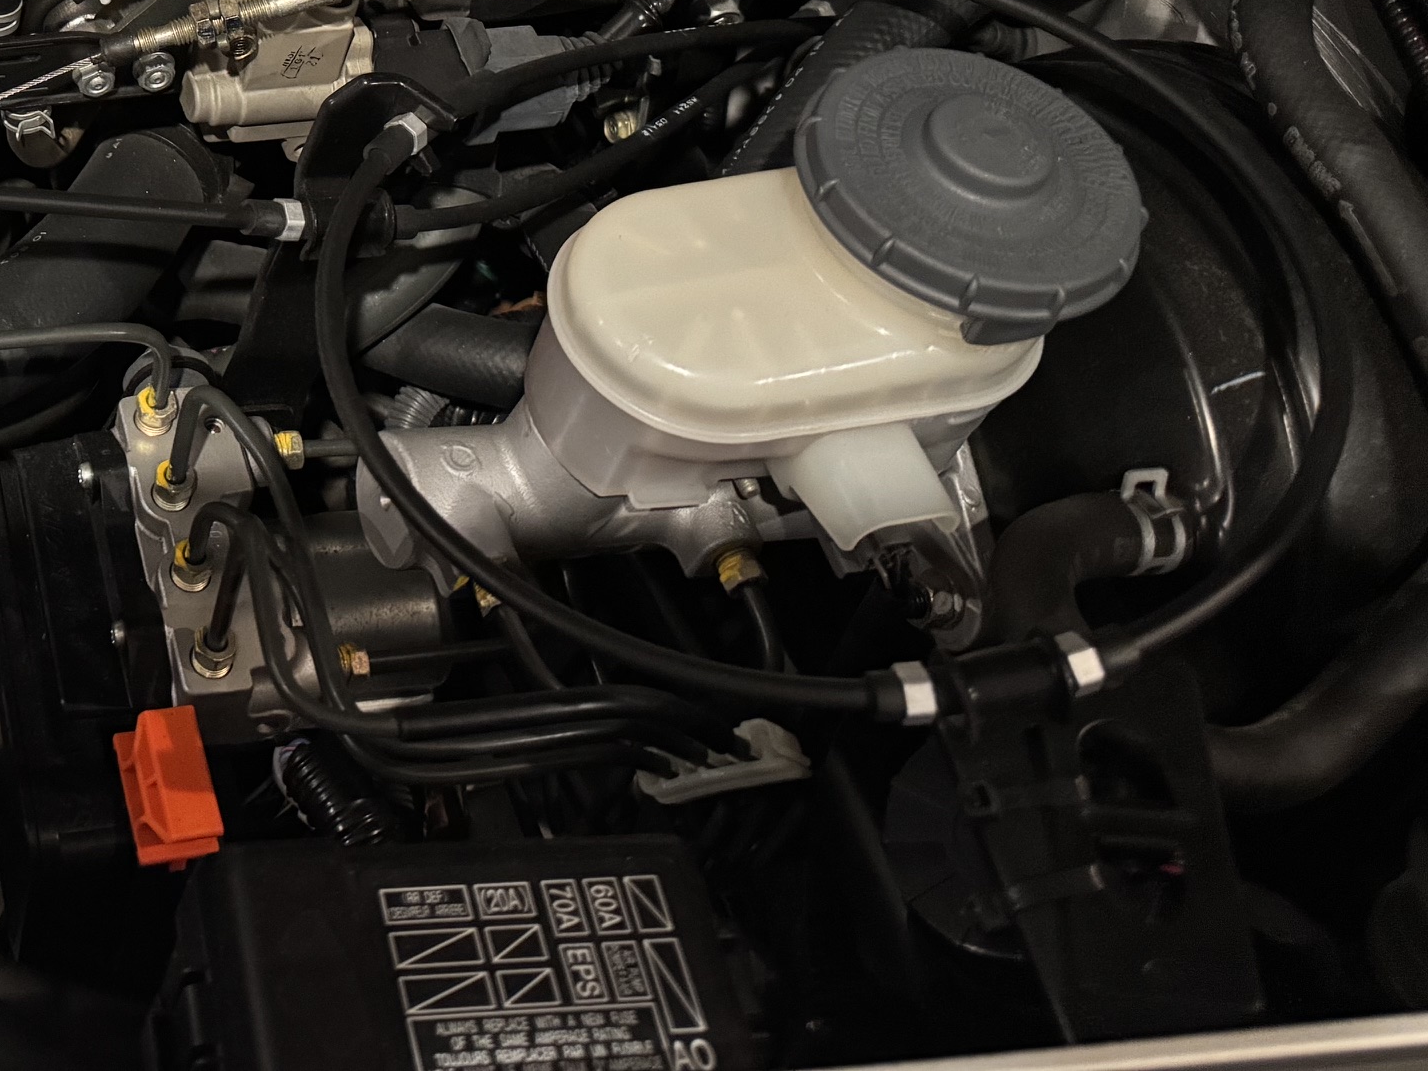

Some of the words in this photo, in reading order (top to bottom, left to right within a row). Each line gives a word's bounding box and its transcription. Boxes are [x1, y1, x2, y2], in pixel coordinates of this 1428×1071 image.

[479, 887, 532, 915] (20A)
[549, 885, 581, 930] 70A
[589, 883, 623, 928] 60A
[566, 949, 601, 997] EPS
[436, 1019, 480, 1036] ALWAYS
[482, 1016, 531, 1033] REPLACE
[591, 1025, 633, 1041] RATING
